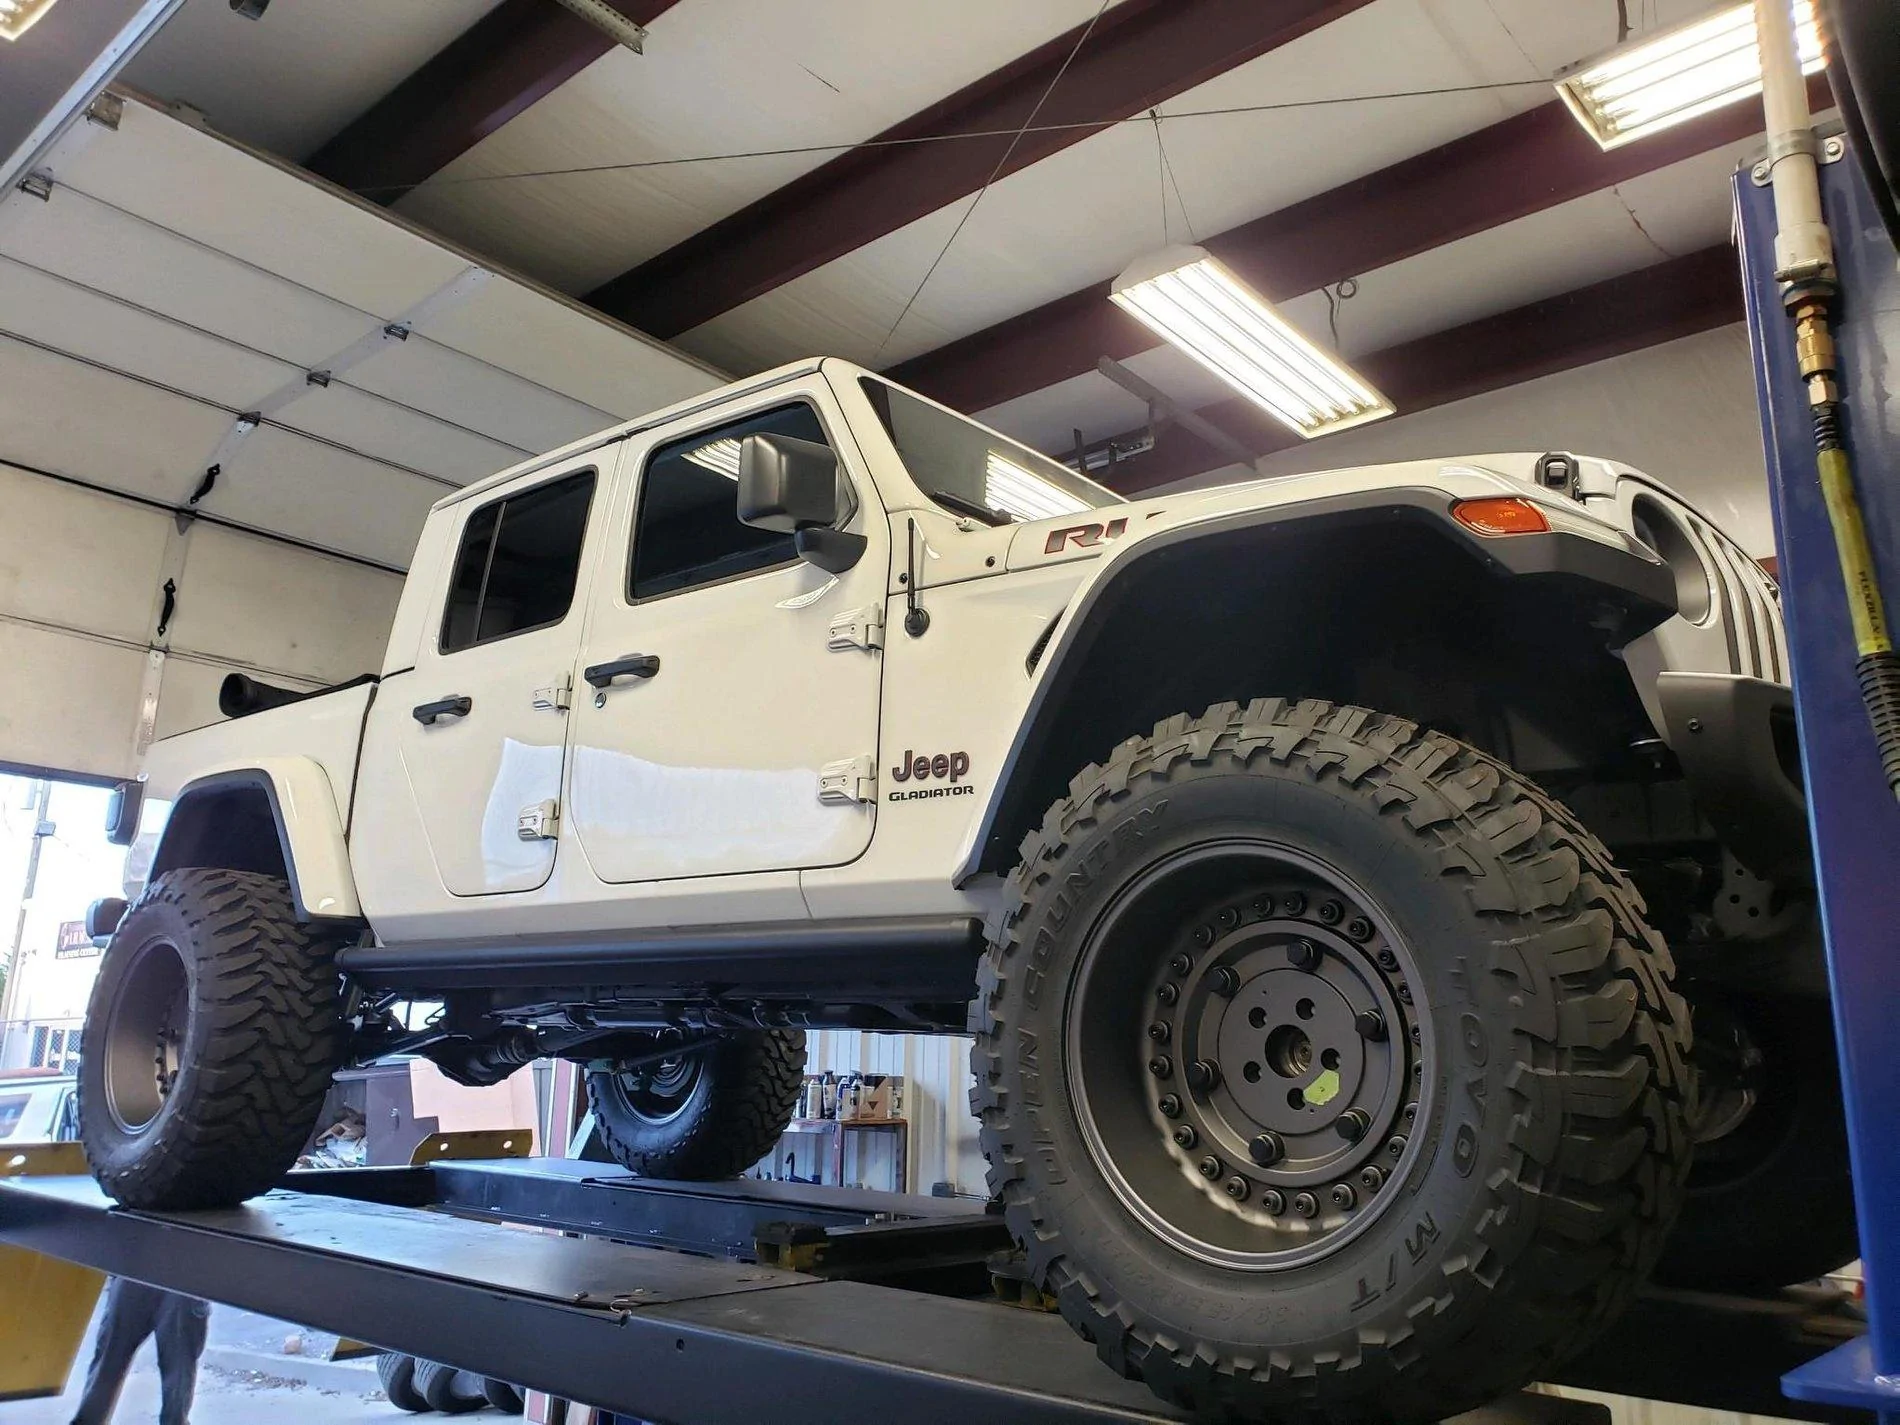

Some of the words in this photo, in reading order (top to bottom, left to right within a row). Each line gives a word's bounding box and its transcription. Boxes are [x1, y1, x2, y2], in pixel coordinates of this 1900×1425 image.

[888, 785, 974, 802] GLADIATOR
[892, 749, 970, 783] Jeep
[1024, 798, 1169, 1011] COUNTRY
[1350, 1211, 1441, 1313] M/T
